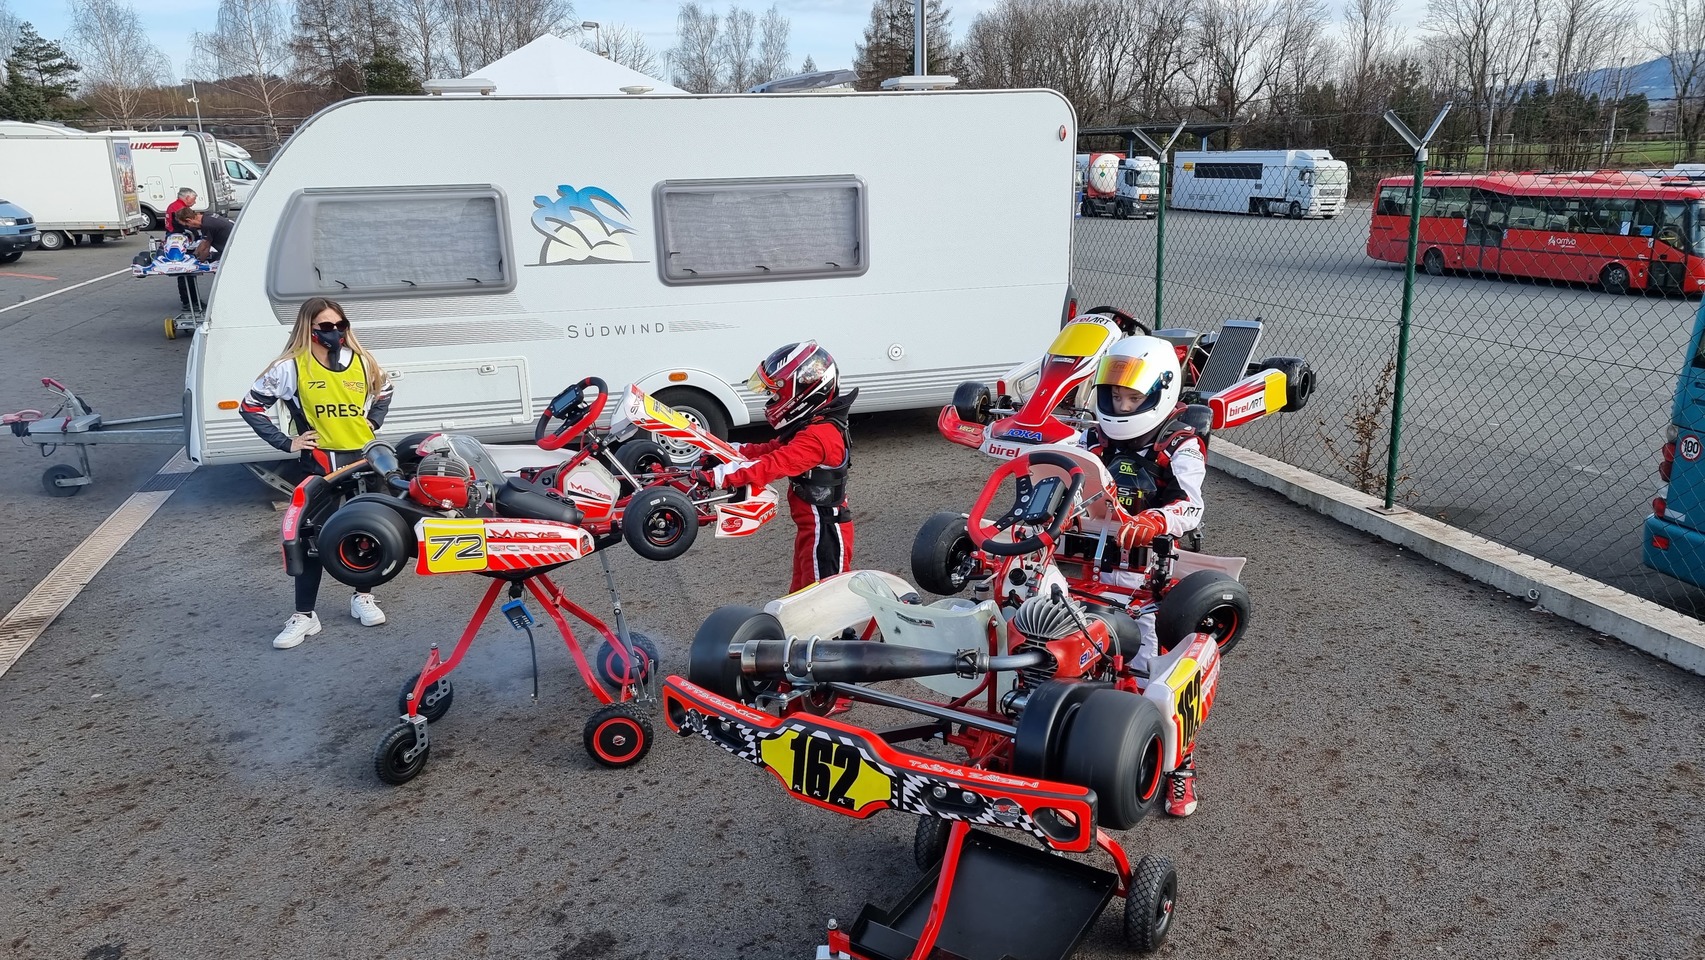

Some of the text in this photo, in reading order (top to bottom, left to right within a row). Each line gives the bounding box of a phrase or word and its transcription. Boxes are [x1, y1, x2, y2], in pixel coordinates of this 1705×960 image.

[567, 322, 665, 339] SÜDWIND
[307, 380, 327, 390] 72
[1229, 396, 1263, 417] birelART
[1003, 428, 1044, 442] JOKA
[1683, 440, 1699, 455] 100
[429, 533, 485, 562] 72
[1177, 668, 1201, 753] 162
[789, 732, 861, 811] 162
